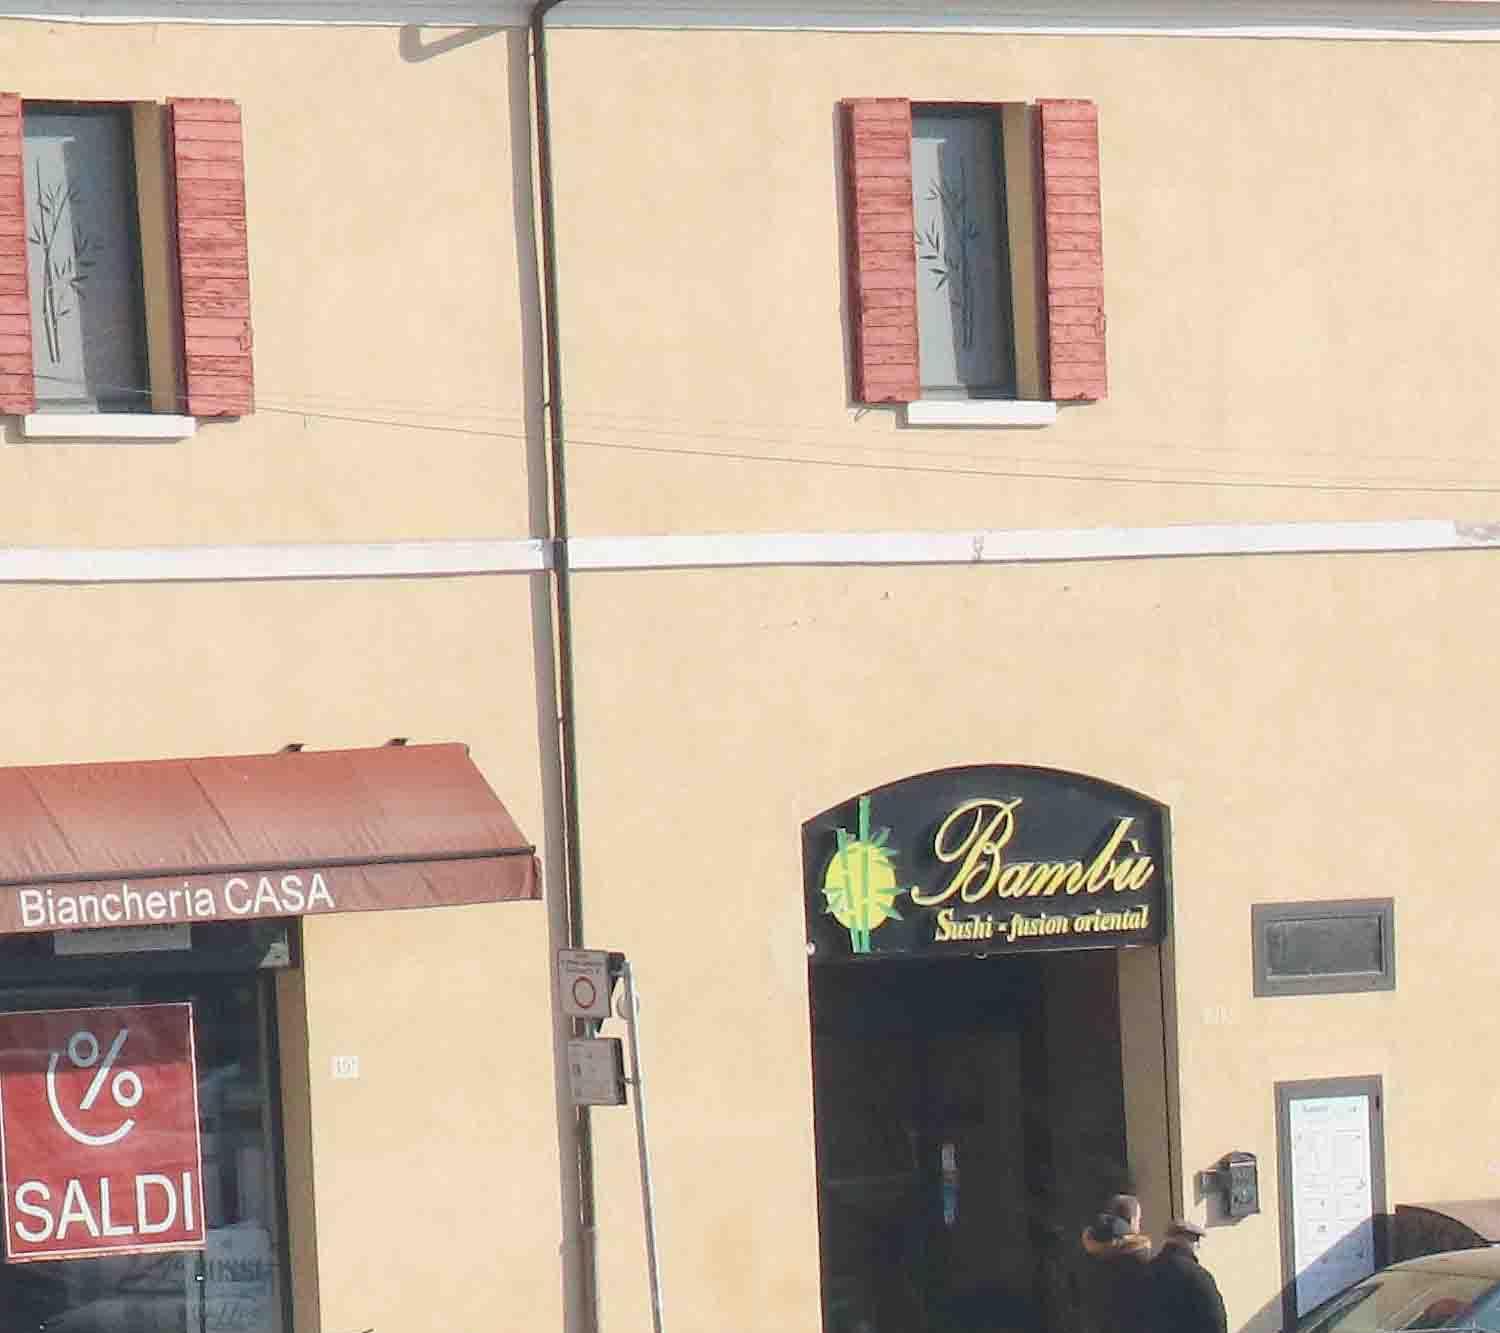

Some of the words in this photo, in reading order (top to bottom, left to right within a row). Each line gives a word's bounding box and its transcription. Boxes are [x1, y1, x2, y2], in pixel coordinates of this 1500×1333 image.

[911, 797, 1155, 906] Bambù
[19, 882, 217, 927] Biancheria
[223, 873, 335, 914] CASA
[934, 906, 993, 942] Sushi
[1007, 912, 1070, 942] fusion
[1073, 904, 1149, 933] oriental
[15, 1171, 195, 1243] SALDI
